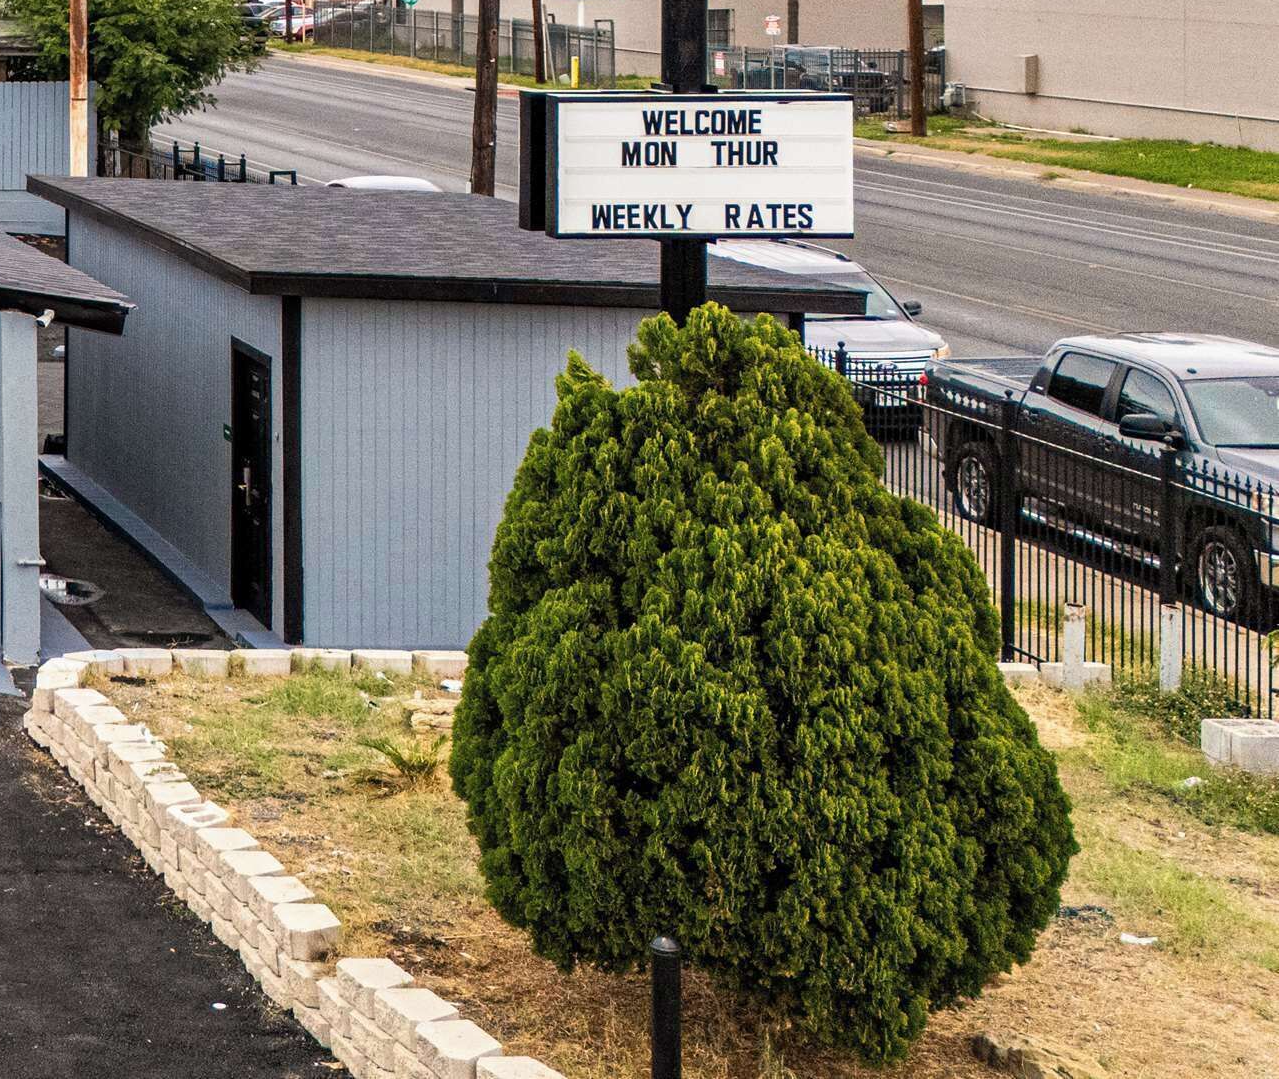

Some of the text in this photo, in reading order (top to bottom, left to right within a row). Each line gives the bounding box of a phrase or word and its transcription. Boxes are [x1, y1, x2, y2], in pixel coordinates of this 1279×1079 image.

[642, 109, 762, 135] WELCOME
[621, 140, 779, 167] MON THUR
[591, 203, 814, 230] WEEKLY RATES
